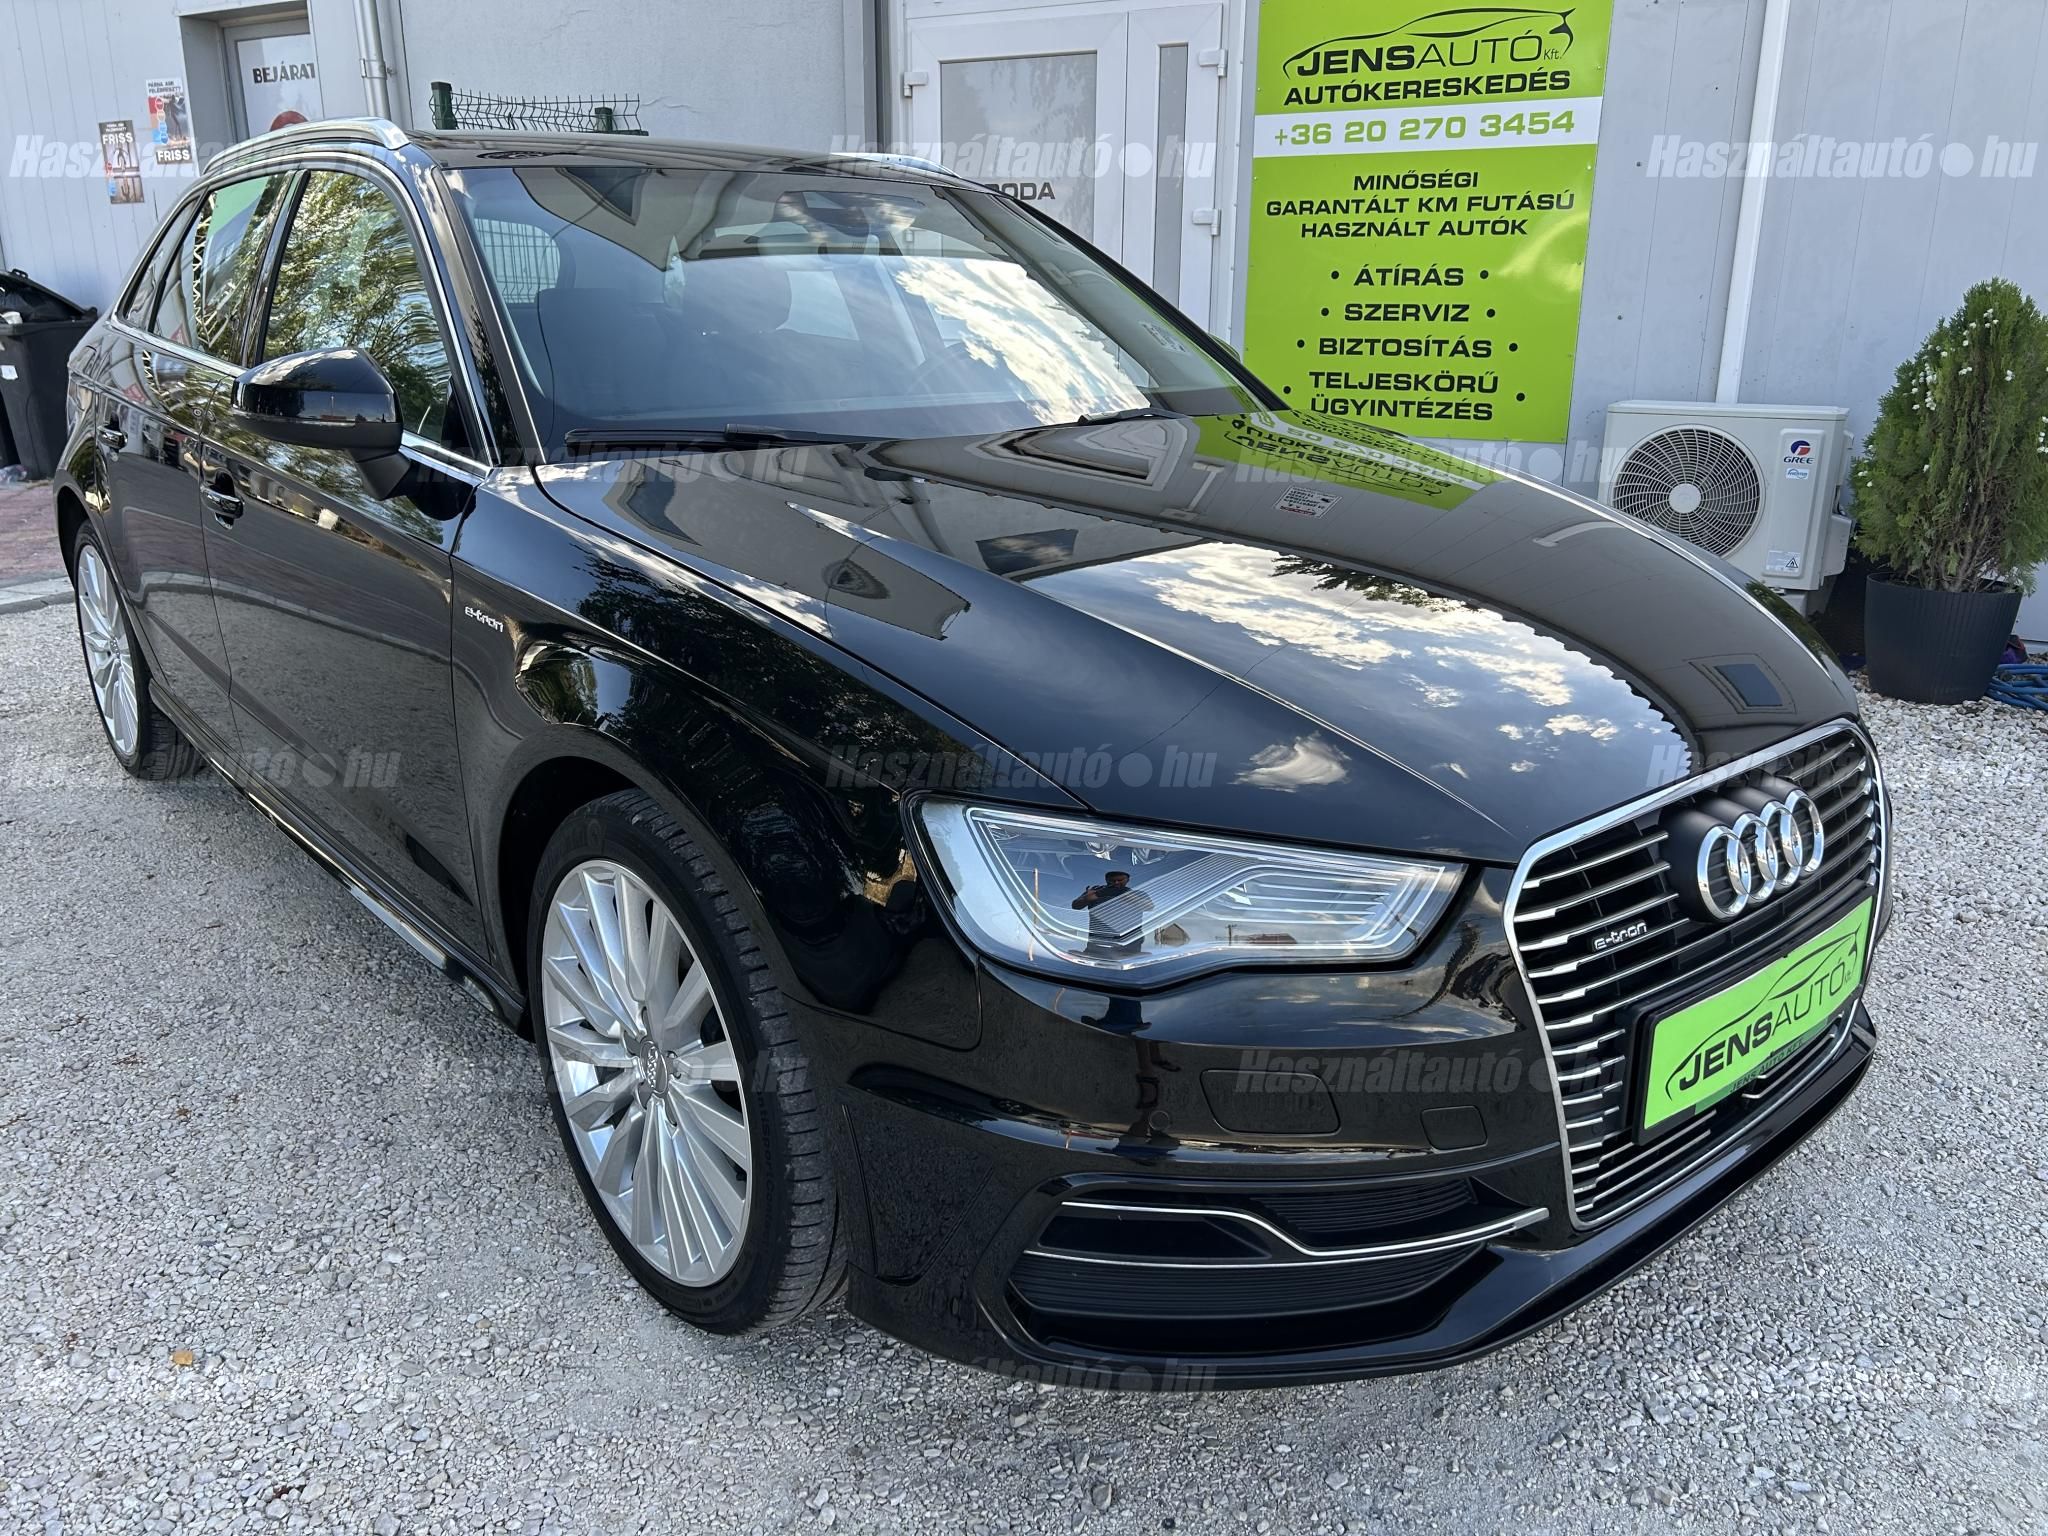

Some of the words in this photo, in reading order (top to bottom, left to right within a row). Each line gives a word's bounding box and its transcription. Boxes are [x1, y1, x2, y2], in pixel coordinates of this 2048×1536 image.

[1284, 66, 1571, 106] AUTÓKERESKEDÉS
[102, 132, 133, 145] FRISS
[1275, 122, 1332, 146] +36
[1344, 120, 1387, 143] 20
[1400, 116, 1466, 141] 270
[1480, 110, 1575, 138] 3454
[157, 149, 190, 162] FRISS
[1353, 169, 1479, 191] MINŐSÉGI
[1266, 194, 1410, 217] GARANTÁLT
[1417, 196, 1458, 214] KM
[1466, 189, 1575, 212] FUTÁSÚ
[1301, 217, 1430, 238] HASZNÁLT
[1438, 213, 1529, 237] AUTÓK
[1353, 264, 1464, 287] ÁTÍRÁS
[1344, 303, 1470, 322] SZERVIZ
[1319, 335, 1493, 358] BIZTOSÍTÁS
[1309, 370, 1499, 394] TELJESKÖRŰ
[1311, 393, 1493, 421] ÜGYINTÉZÉS
[1783, 456, 1815, 465] GREE
[465, 606, 504, 633] e-tron
[1594, 922, 1647, 950] e-tron
